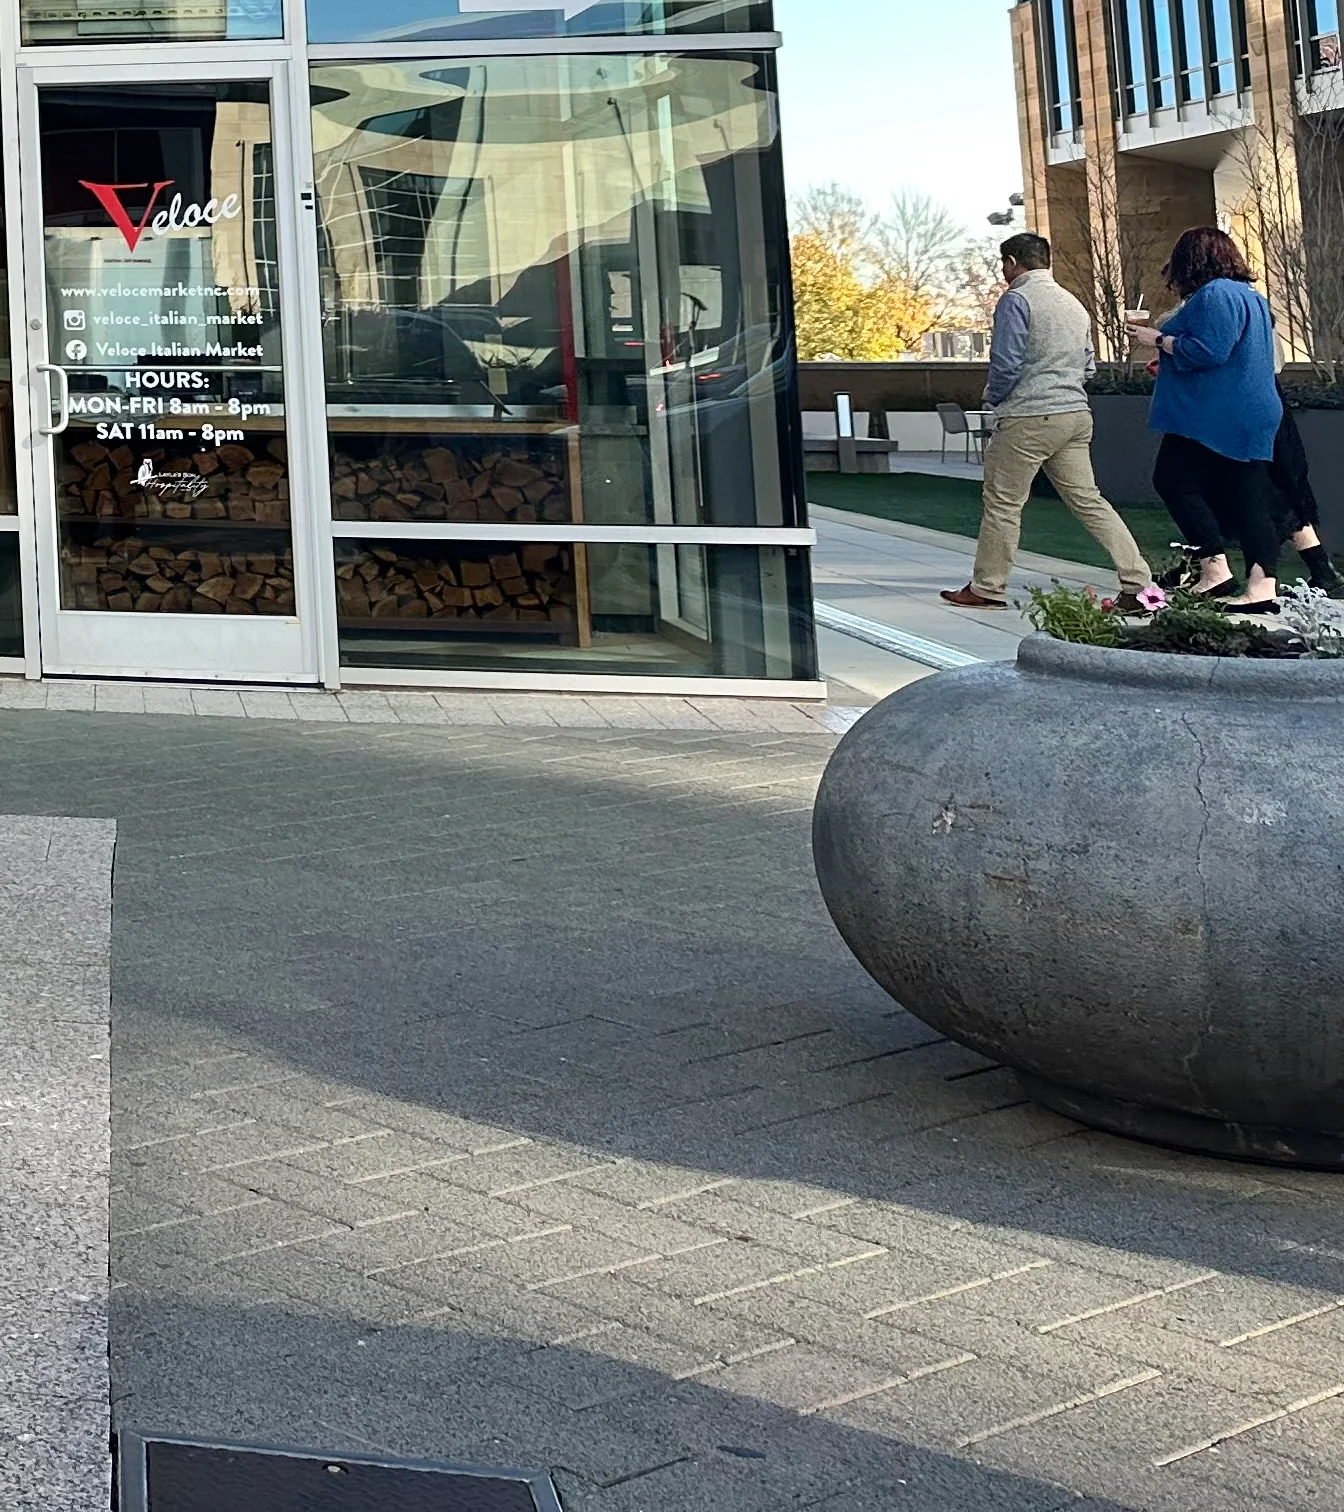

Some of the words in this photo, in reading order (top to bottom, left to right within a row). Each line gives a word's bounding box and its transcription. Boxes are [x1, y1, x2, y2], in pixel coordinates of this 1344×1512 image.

[78, 180, 242, 254] Veloce
[61, 282, 260, 297] www.velocemarketnc.com
[93, 310, 263, 327] veloce_italian_market
[96, 342, 147, 357] Veloce
[151, 342, 201, 357] Italian
[206, 342, 264, 357] Market
[125, 371, 210, 389] HOURS:
[69, 396, 163, 414] MON-FRI
[169, 398, 210, 415] 8am
[227, 398, 271, 420] 8pm
[96, 422, 134, 440] SAT
[138, 423, 184, 440] 11am
[201, 423, 245, 446] 8pm
